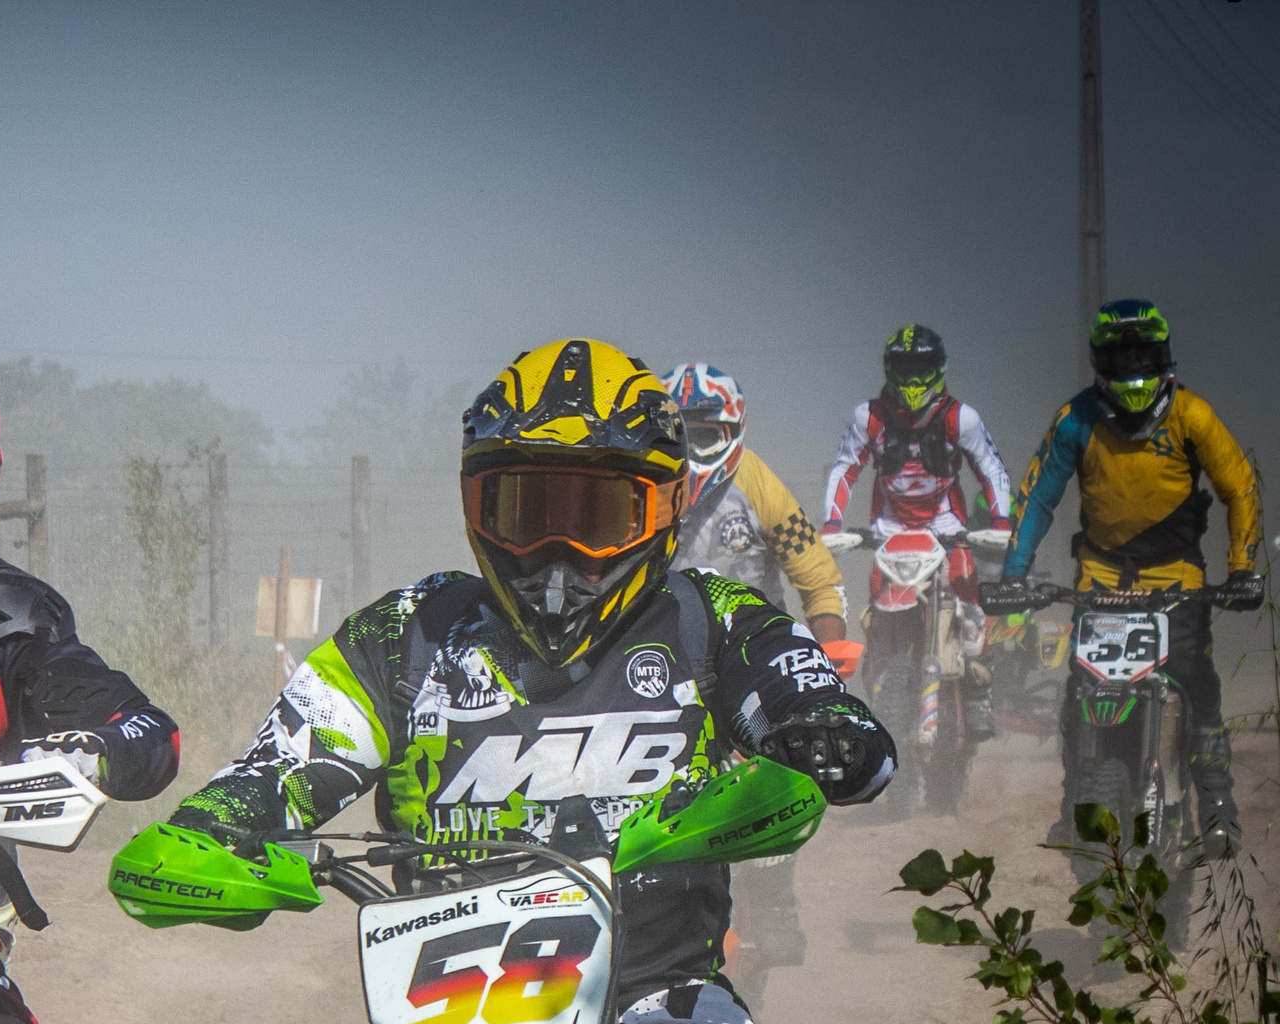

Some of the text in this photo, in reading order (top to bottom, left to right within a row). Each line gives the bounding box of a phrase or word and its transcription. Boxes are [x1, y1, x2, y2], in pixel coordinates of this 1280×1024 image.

[636, 666, 661, 677] MTB
[416, 712, 438, 730] 40
[434, 709, 687, 804] MTB
[3, 800, 66, 822] IMS
[434, 806, 501, 833] LOVE
[707, 792, 818, 850] RACTECH
[113, 869, 225, 901] RACETECH
[509, 891, 585, 907] VASCAR
[365, 894, 480, 949] Kawasaki
